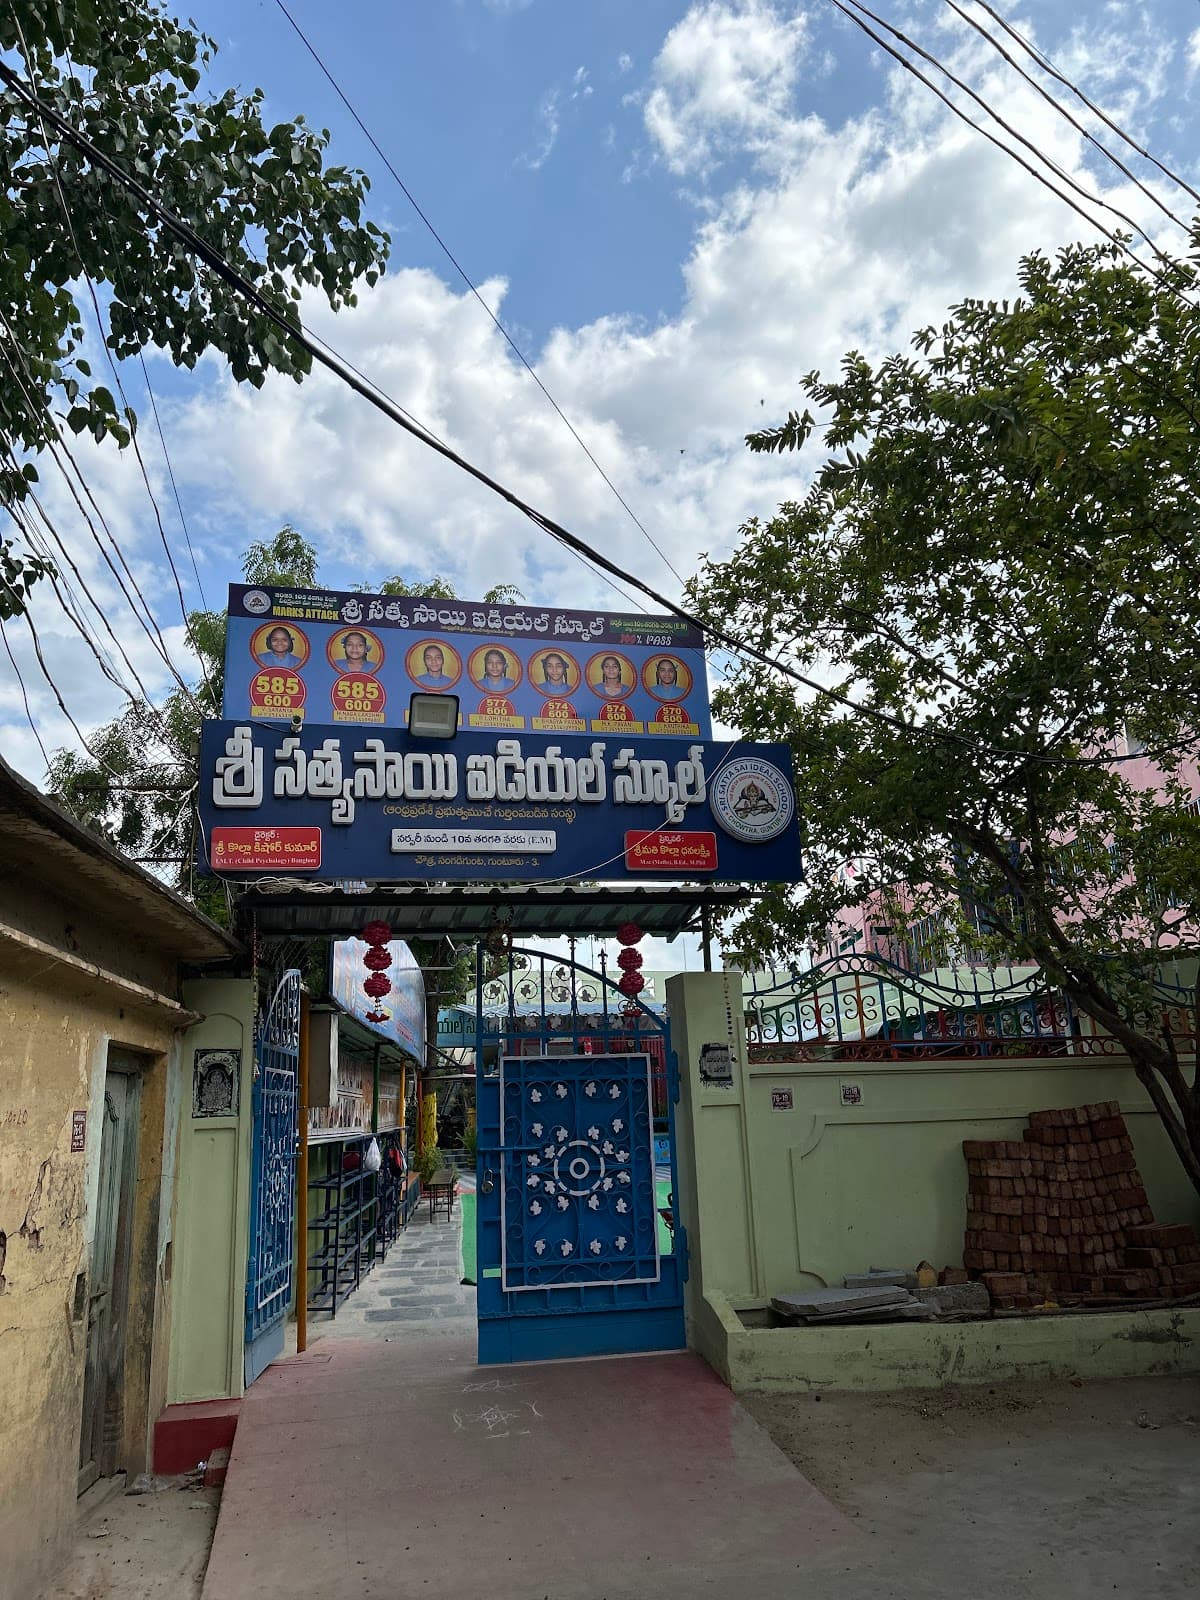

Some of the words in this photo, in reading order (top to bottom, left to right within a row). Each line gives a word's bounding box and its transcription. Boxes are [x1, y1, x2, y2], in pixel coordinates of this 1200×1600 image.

[272, 606, 305, 618] MARKS
[305, 608, 339, 620] ATTACK
[340, 598, 364, 625] శ్రీ
[472, 609, 550, 633] ఐడియల్
[553, 614, 605, 641] స్కూల్
[646, 635, 672, 646] PASS
[256, 676, 299, 695] 585
[337, 680, 379, 699] 585
[263, 695, 291, 707] 600
[345, 700, 372, 711] 600
[486, 699, 508, 707] 577
[548, 702, 569, 710] 574
[486, 707, 507, 716] 600
[548, 710, 569, 719] 600
[606, 704, 626, 713] 574
[662, 707, 682, 715] 570
[607, 713, 627, 721] 600
[663, 715, 682, 723] 600
[734, 764, 748, 774] SAI
[750, 763, 776, 779] IDEAL
[213, 727, 263, 808] శ్రీ
[466, 739, 607, 802] ఐడియల్
[612, 745, 707, 824] స్కూల్
[719, 770, 735, 795] SATYA
[773, 777, 788, 814] SCHOOL
[719, 797, 728, 812] SRI
[397, 833, 422, 847] నర్సరీ
[423, 833, 449, 844] నుండి
[473, 834, 501, 845] తరగతి
[503, 835, 526, 845] వరకు
[215, 841, 225, 855] శ్రీ
[254, 841, 282, 854] కిషోర్
[284, 841, 318, 853] కుమార్
